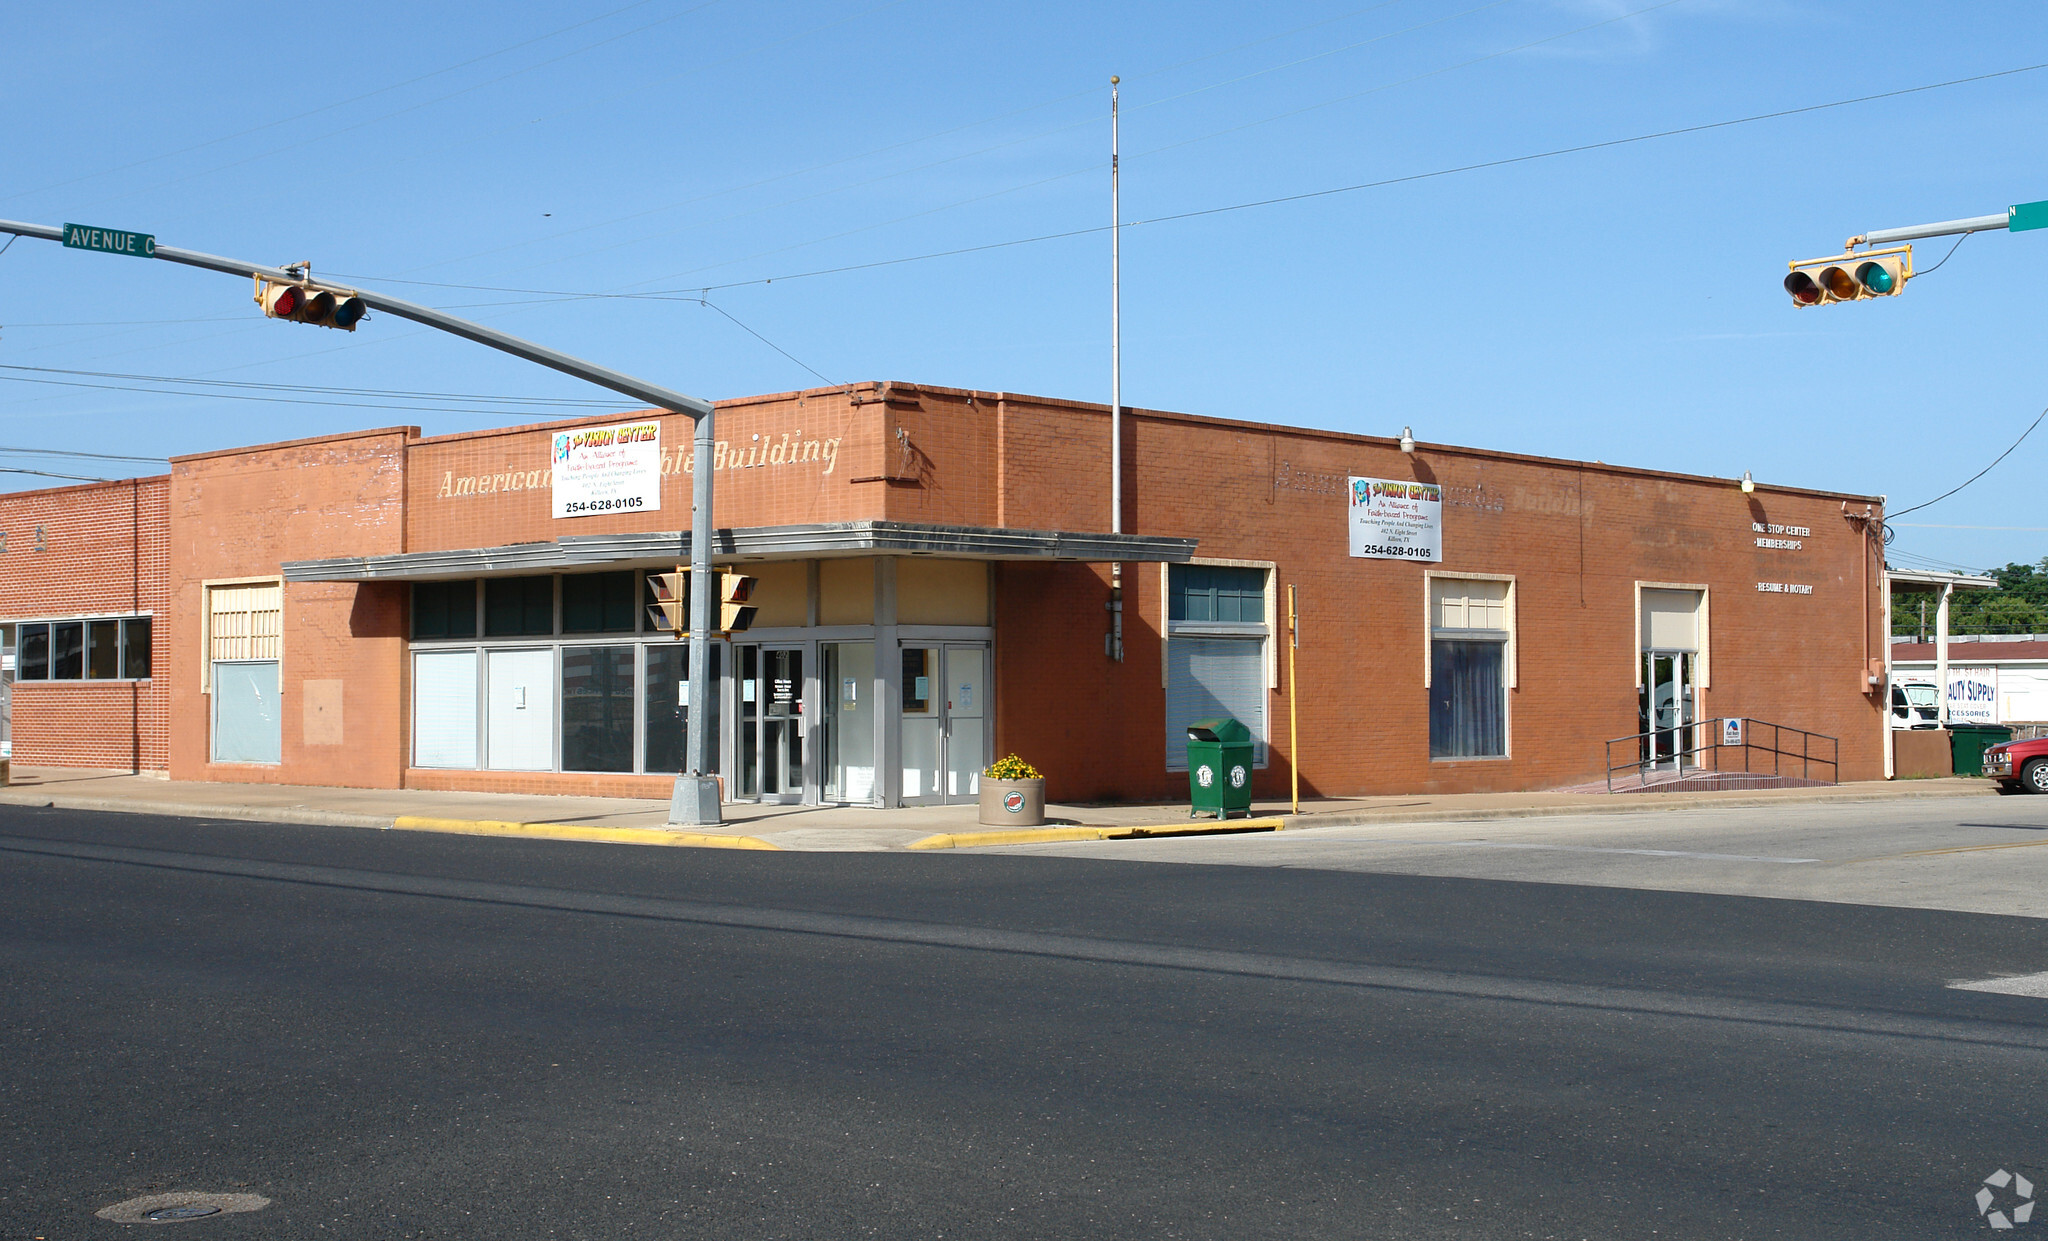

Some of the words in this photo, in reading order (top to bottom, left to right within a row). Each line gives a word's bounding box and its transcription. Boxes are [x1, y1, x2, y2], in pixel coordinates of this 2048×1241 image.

[2009, 205, 2016, 216] N
[64, 223, 69, 232] E
[70, 228, 136, 252] AVENUE
[145, 237, 155, 254] C
[583, 429, 615, 447] VISION
[617, 424, 657, 444] CENTER
[437, 462, 552, 499] American
[714, 429, 842, 475] Building
[1380, 482, 1407, 499] VISION
[1408, 484, 1440, 503] CENTER
[566, 497, 643, 513] 254-628-0105
[1389, 501, 1410, 510] Alliance
[1411, 502, 1419, 513] of
[1381, 519, 1395, 527] People
[1403, 511, 1429, 521] Programs
[1752, 522, 1766, 533] ONE
[1767, 523, 1785, 535] STOP
[1785, 525, 1811, 537] CENTER
[1364, 544, 1431, 558] 254-628-0105
[1757, 582, 1783, 594] RESUME
[1784, 583, 1790, 593] &
[1789, 584, 1814, 595] NOTARY
[1948, 680, 1965, 701] AUTY
[1967, 680, 1995, 702] SUPPLY
[1949, 710, 1990, 718] CESSORIES
